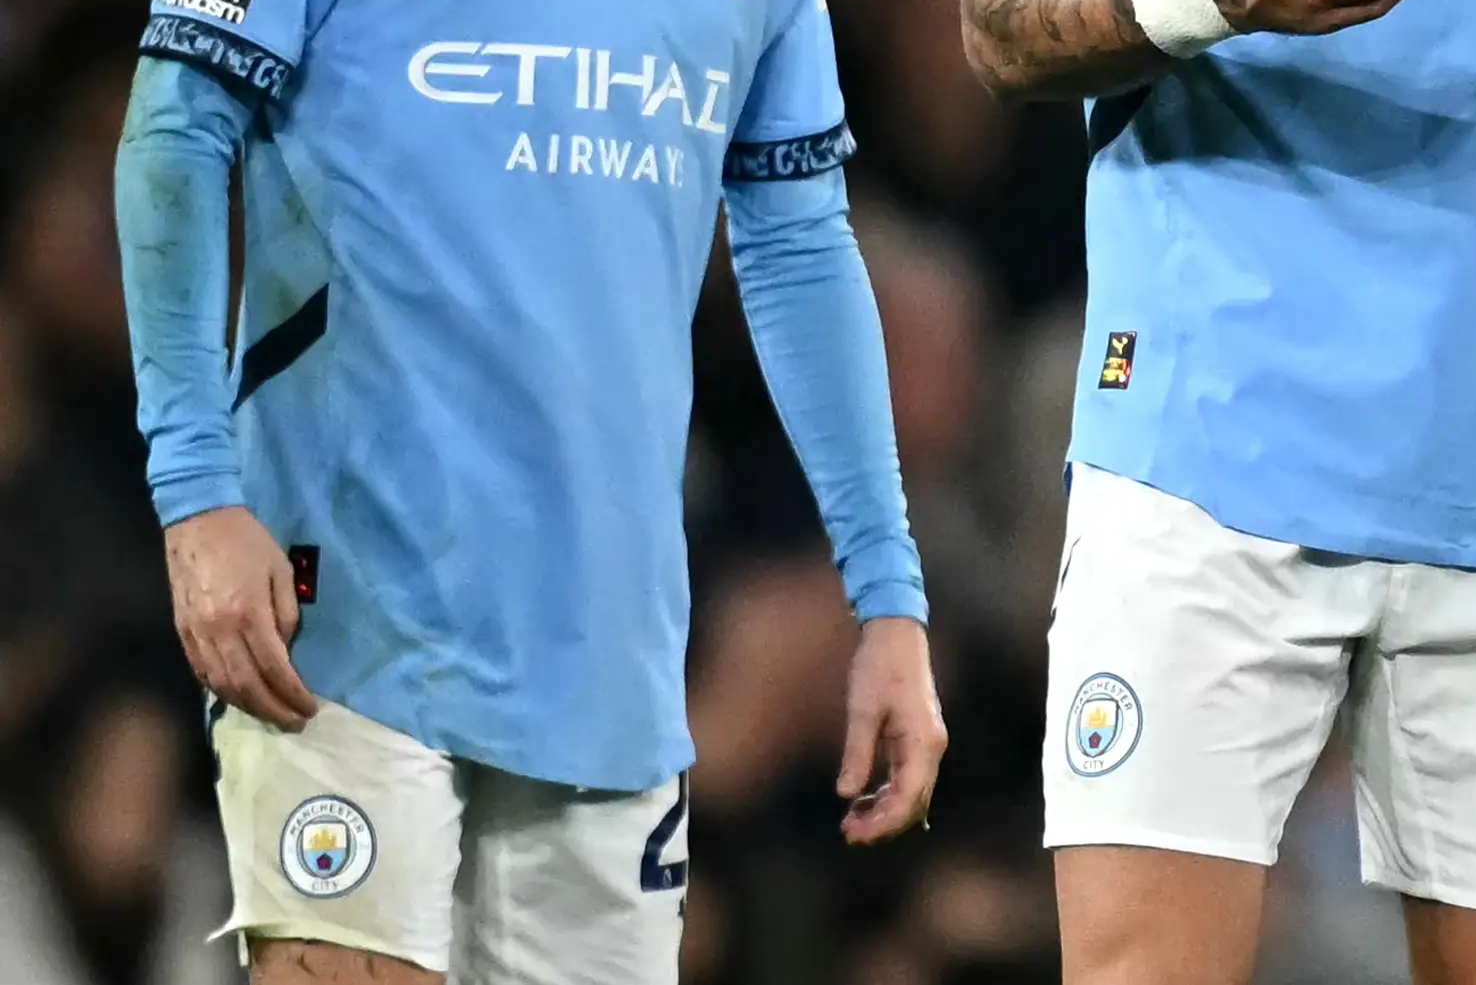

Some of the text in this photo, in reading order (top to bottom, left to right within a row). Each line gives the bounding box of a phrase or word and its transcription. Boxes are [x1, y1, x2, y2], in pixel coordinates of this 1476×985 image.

[1083, 759, 1105, 770] CITY
[289, 803, 365, 835] MANCHESTER
[312, 880, 338, 891] CITY
